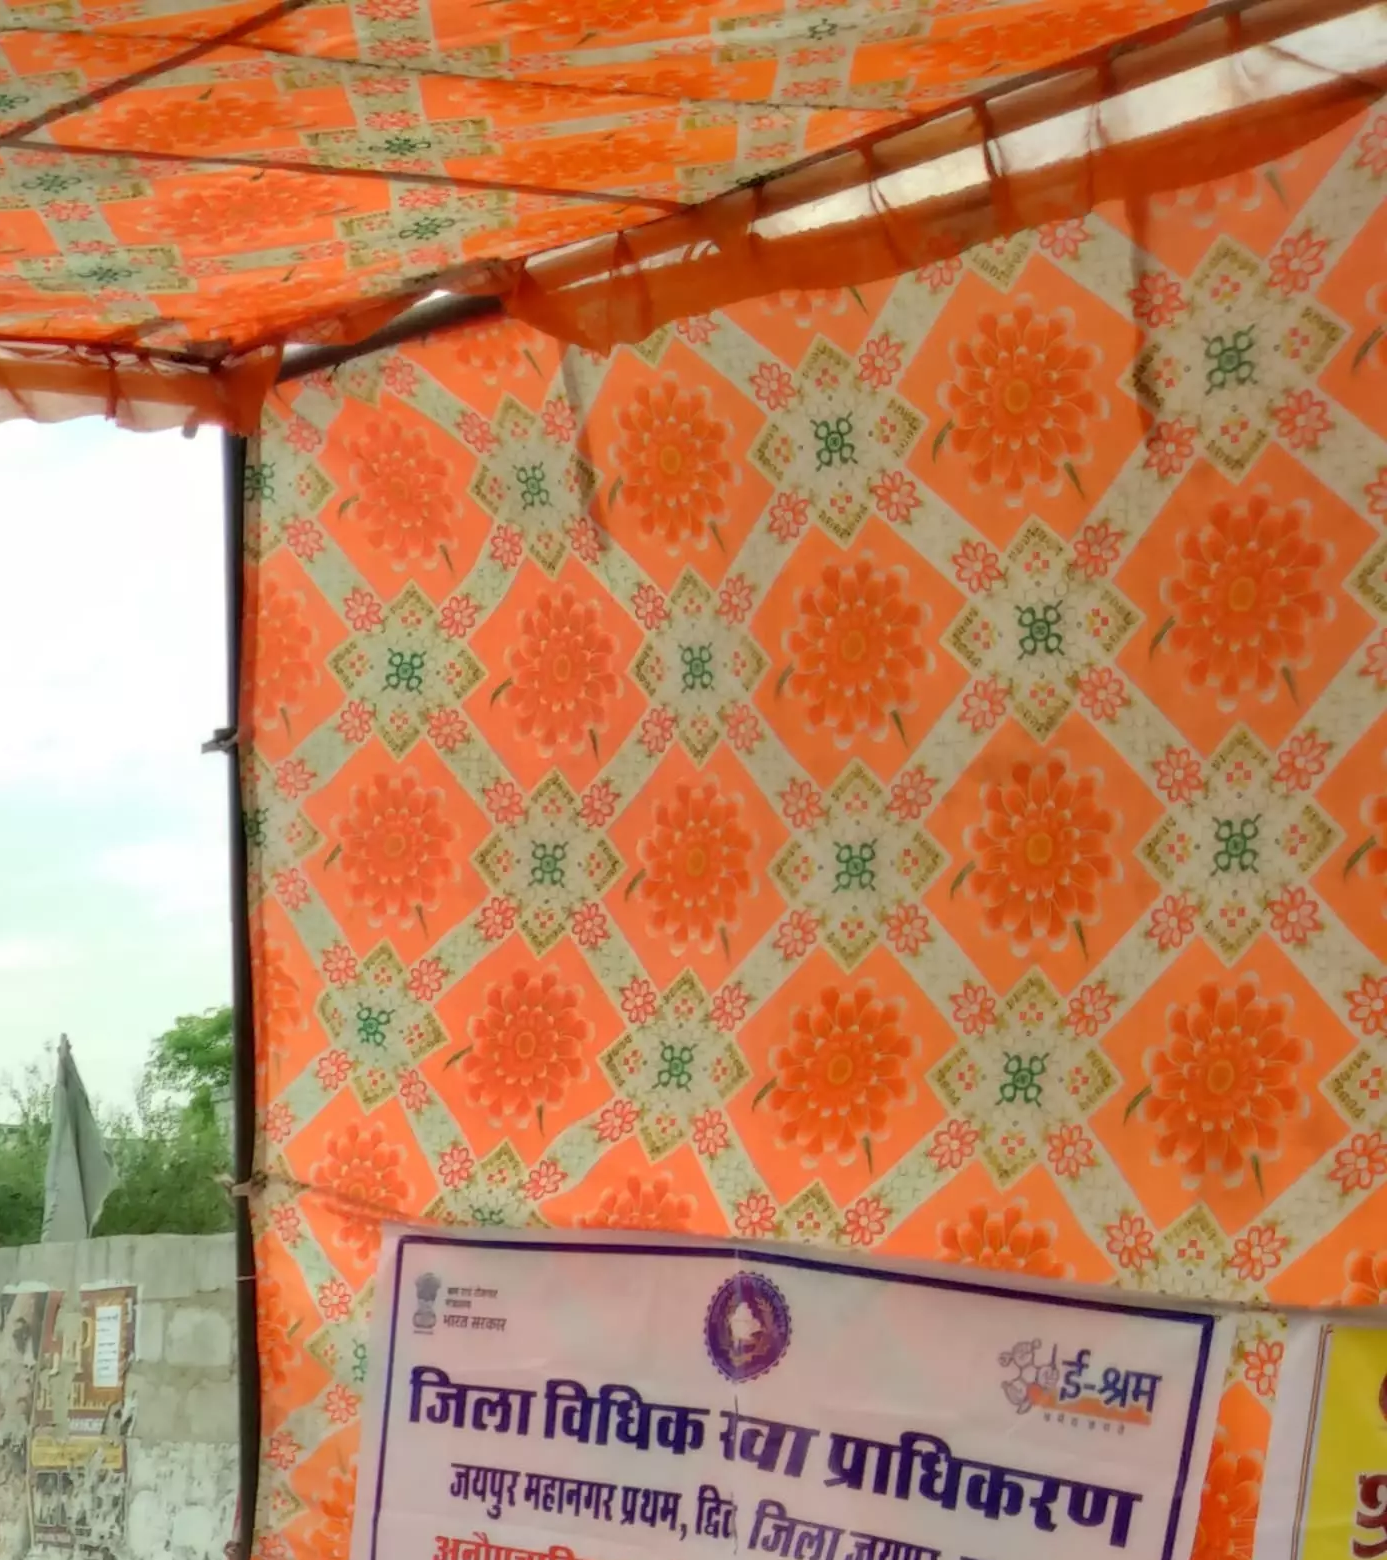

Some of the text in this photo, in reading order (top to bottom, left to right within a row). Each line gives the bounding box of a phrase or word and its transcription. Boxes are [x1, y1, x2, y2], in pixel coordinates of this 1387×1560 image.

[443, 1314, 507, 1332] भारत सरकार
[409, 1366, 537, 1436] जिला
[544, 1379, 711, 1455] विधिक
[824, 1431, 1143, 1549] प्राधिकरण
[450, 1462, 521, 1520] जयपुर
[524, 1472, 617, 1521] महानगर
[620, 1484, 688, 1542] प्रथम,
